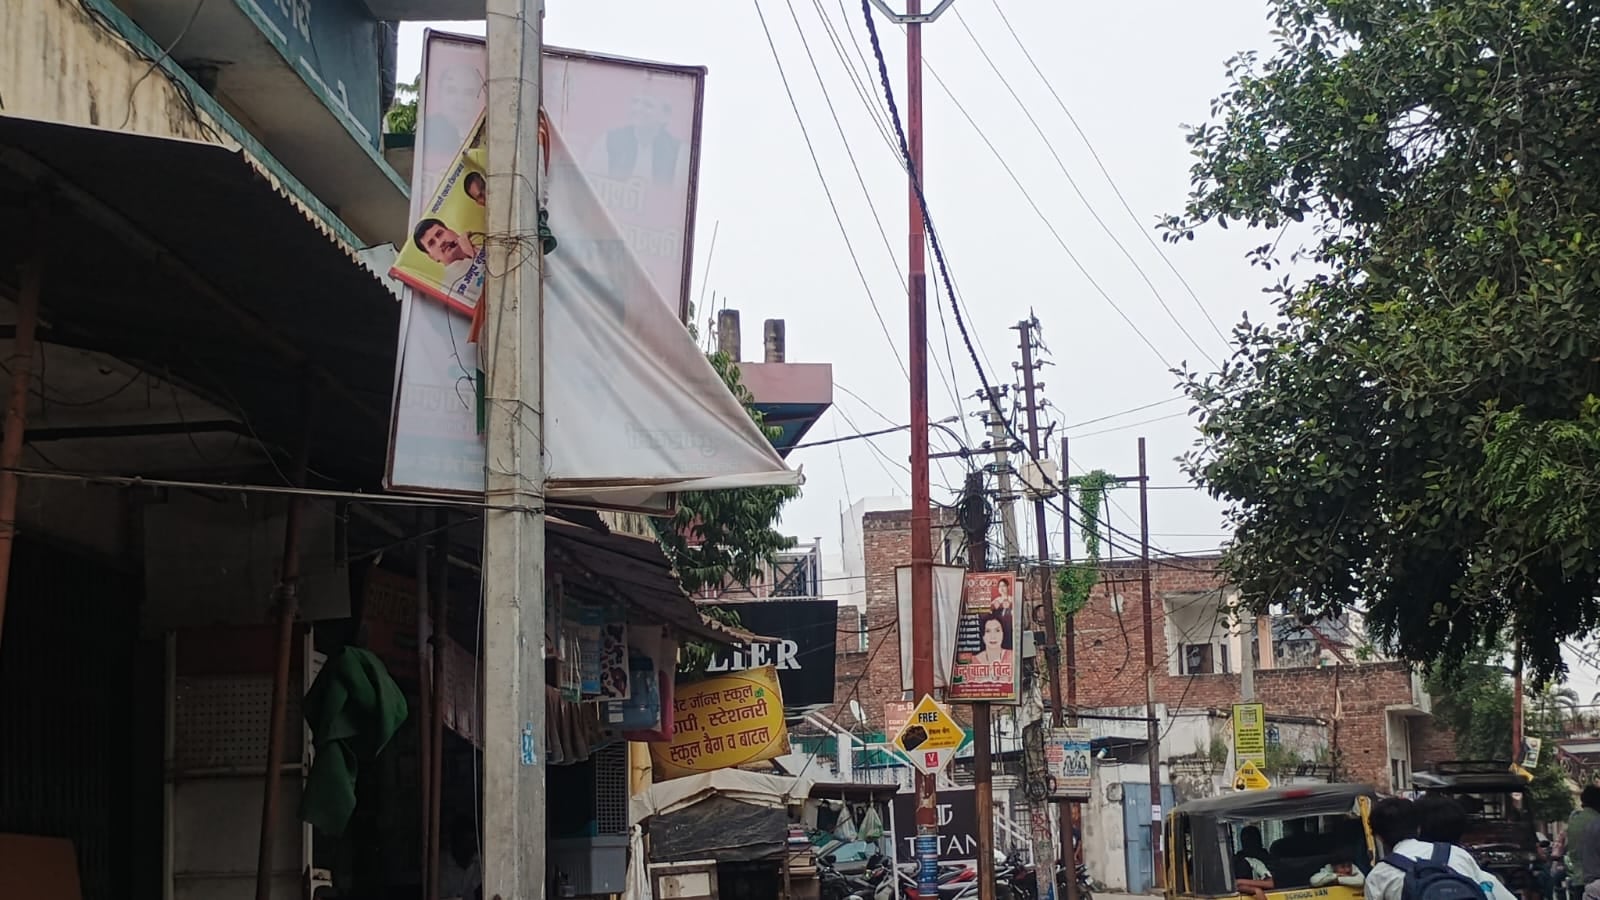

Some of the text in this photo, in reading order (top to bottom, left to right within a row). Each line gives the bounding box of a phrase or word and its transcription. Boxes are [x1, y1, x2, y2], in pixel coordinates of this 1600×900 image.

[683, 640, 801, 672] LIER
[689, 692, 720, 708] जॉन्स
[723, 685, 753, 703] स्कूल
[708, 698, 768, 726] स्टेशनरी
[918, 712, 938, 723] FREE
[669, 741, 701, 765] स्कूल
[704, 733, 724, 754] बैग
[726, 734, 736, 749] व
[904, 834, 976, 857] TTAN
